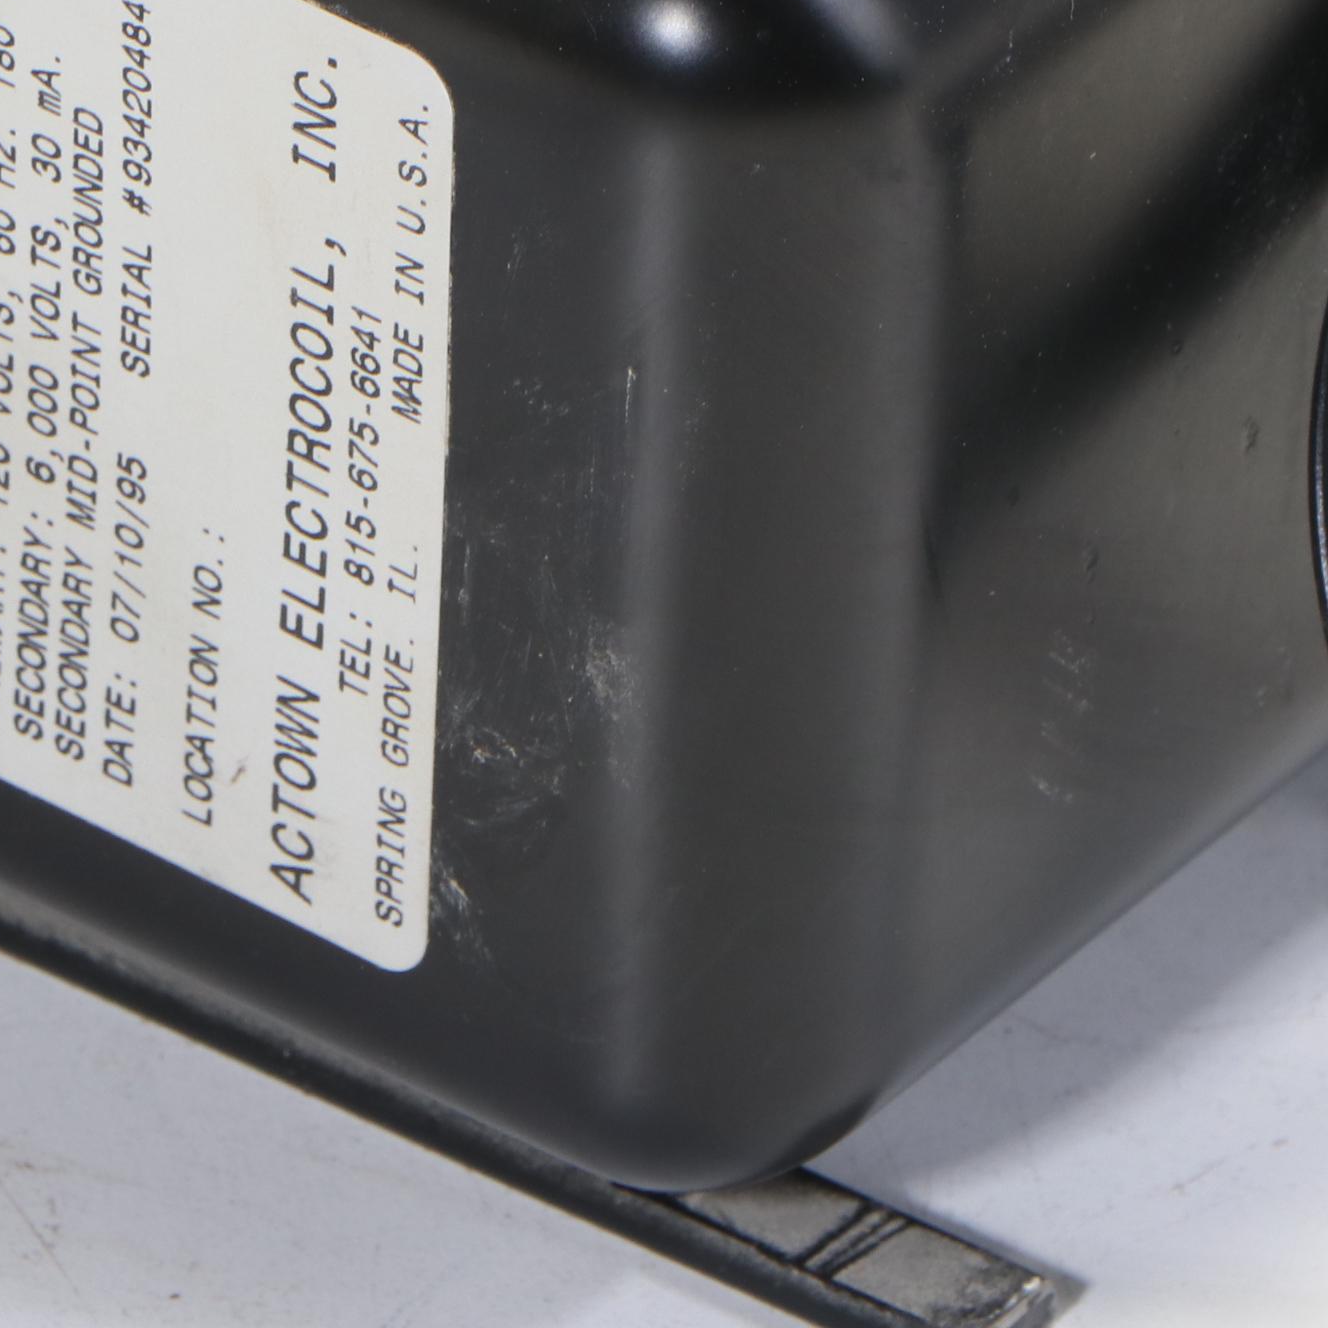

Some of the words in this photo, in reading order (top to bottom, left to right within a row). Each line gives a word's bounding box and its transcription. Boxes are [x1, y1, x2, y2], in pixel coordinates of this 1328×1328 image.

[31, 57, 60, 116] mA.
[122, 0, 152, 215] #93420484
[292, 58, 337, 182] INC.
[32, 134, 61, 183] 30
[73, 108, 103, 295] GROUNDED
[397, 106, 428, 234] U.S.A.
[30, 218, 69, 341] VOLTS,
[121, 246, 152, 378] SERIAL
[395, 252, 424, 305] IN
[26, 365, 63, 484] 6,000
[66, 312, 101, 530] MID-POINT
[391, 323, 423, 423] MADE
[279, 238, 346, 650] ELECTROCOIL,
[344, 307, 381, 586] 815-675-6641
[110, 453, 148, 643] 07/10/95
[192, 529, 224, 619] NO.:
[14, 513, 53, 740] SECONDARY:
[55, 547, 92, 760] SECONDARY
[339, 613, 372, 695] TEL:
[103, 674, 136, 787] DATE:
[183, 635, 218, 826] LOCATION
[270, 676, 320, 904] ACTOWN
[375, 787, 406, 927] SPRING
